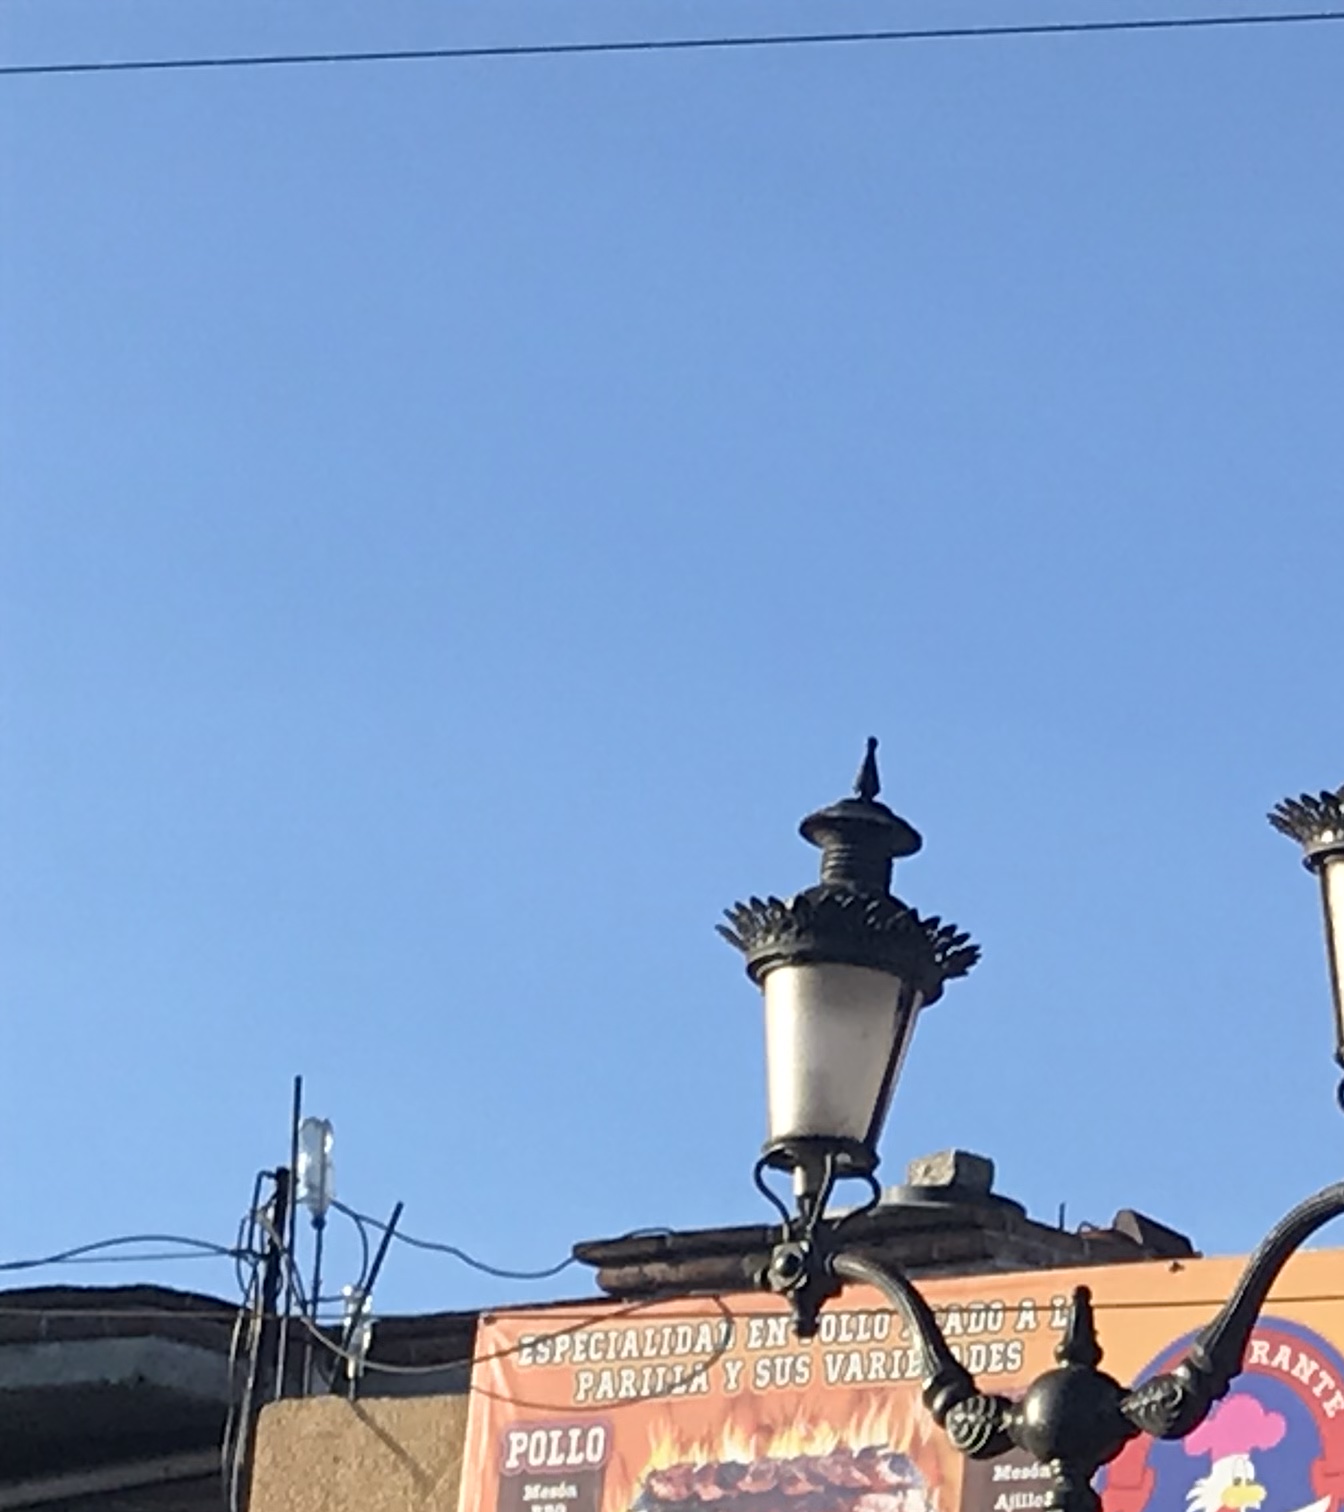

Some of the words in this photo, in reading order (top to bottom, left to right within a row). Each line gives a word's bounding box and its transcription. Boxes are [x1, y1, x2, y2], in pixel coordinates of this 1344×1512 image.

[518, 1318, 736, 1366] ESPECIALIDAD
[747, 1316, 789, 1349] EN
[800, 1312, 891, 1345] OLLO
[1016, 1298, 1037, 1331] A
[724, 1359, 744, 1392] Y
[755, 1354, 812, 1389] SUS
[504, 1425, 606, 1470] POLLO
